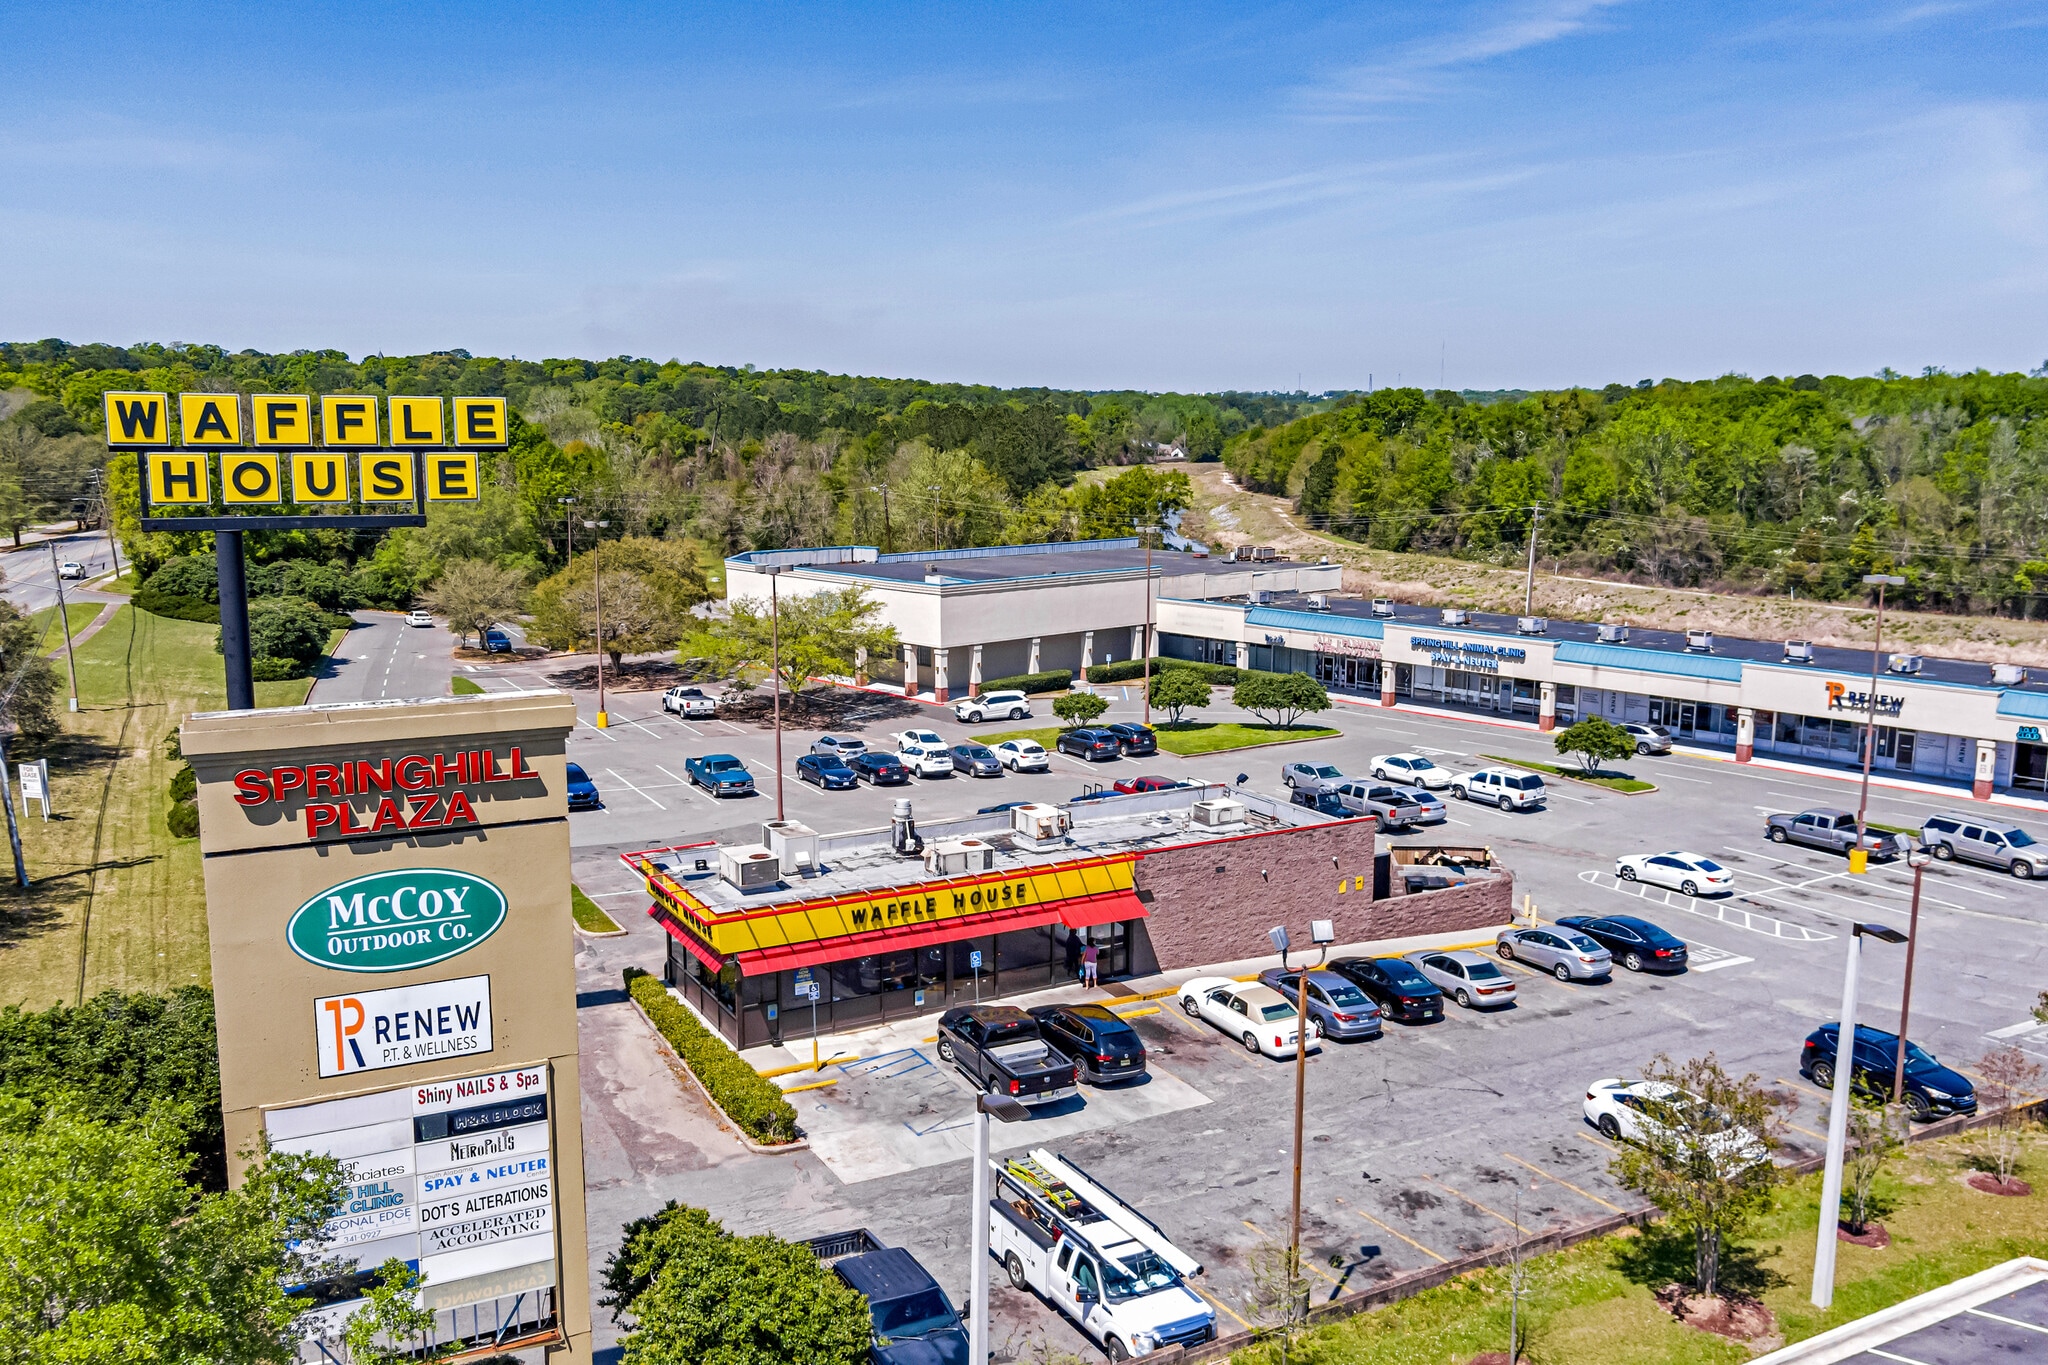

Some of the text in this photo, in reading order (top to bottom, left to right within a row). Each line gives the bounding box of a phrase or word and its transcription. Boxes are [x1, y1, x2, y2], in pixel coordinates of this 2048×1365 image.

[115, 400, 496, 439] WAFFLE
[162, 460, 468, 498] HOUSE
[1410, 636, 1525, 658] SPRING HILL ANIMAL CLINIC
[1431, 651, 1451, 663] SPAY
[1463, 656, 1498, 668] NEUTER
[233, 746, 539, 806] SPRINGHILL
[305, 791, 478, 838] PLAZA
[851, 883, 1025, 925] WAFFLE HOUSE
[375, 1001, 481, 1045] RENEW
[383, 1035, 478, 1062] P.T. & WELLNESS
[418, 1072, 539, 1105] Shiny NAILS & Spa
[455, 1103, 542, 1130] H&R BLOCK
[341, 1165, 405, 1185] sociates
[424, 1166, 473, 1180] South Alabama
[424, 1158, 547, 1192] SPAY & NEUTER
[526, 1169, 548, 1178] Center
[350, 1193, 404, 1214] CLINIC
[357, 1182, 394, 1199] HILL
[421, 1184, 548, 1222] DOT'S ALTERATIONS
[325, 1208, 411, 1233] RSONAL EDGE
[429, 1208, 546, 1240] ACCELERATED
[437, 1220, 540, 1250] ACCOUNTING
